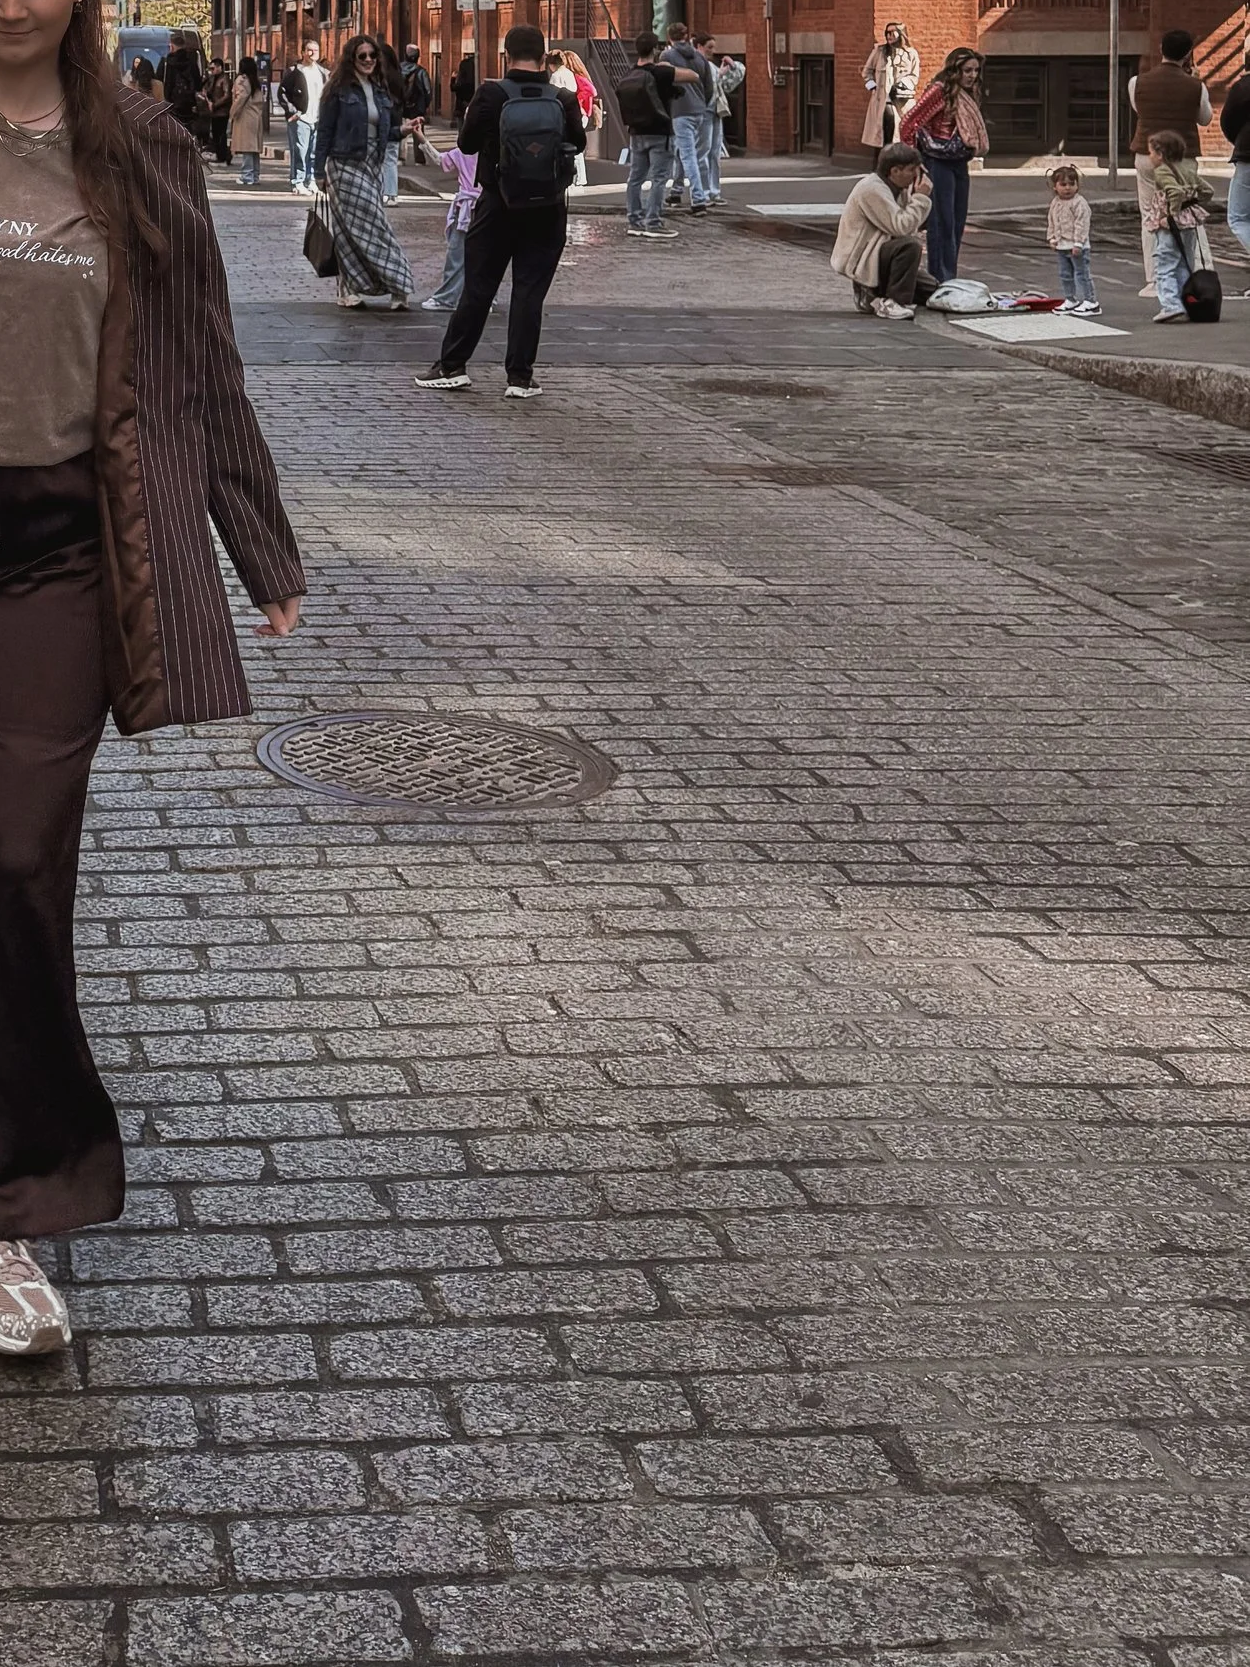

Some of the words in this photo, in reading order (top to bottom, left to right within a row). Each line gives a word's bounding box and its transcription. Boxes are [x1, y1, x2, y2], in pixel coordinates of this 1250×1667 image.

[8, 221, 39, 237] NY
[23, 242, 74, 266] hates
[73, 254, 96, 267] me
